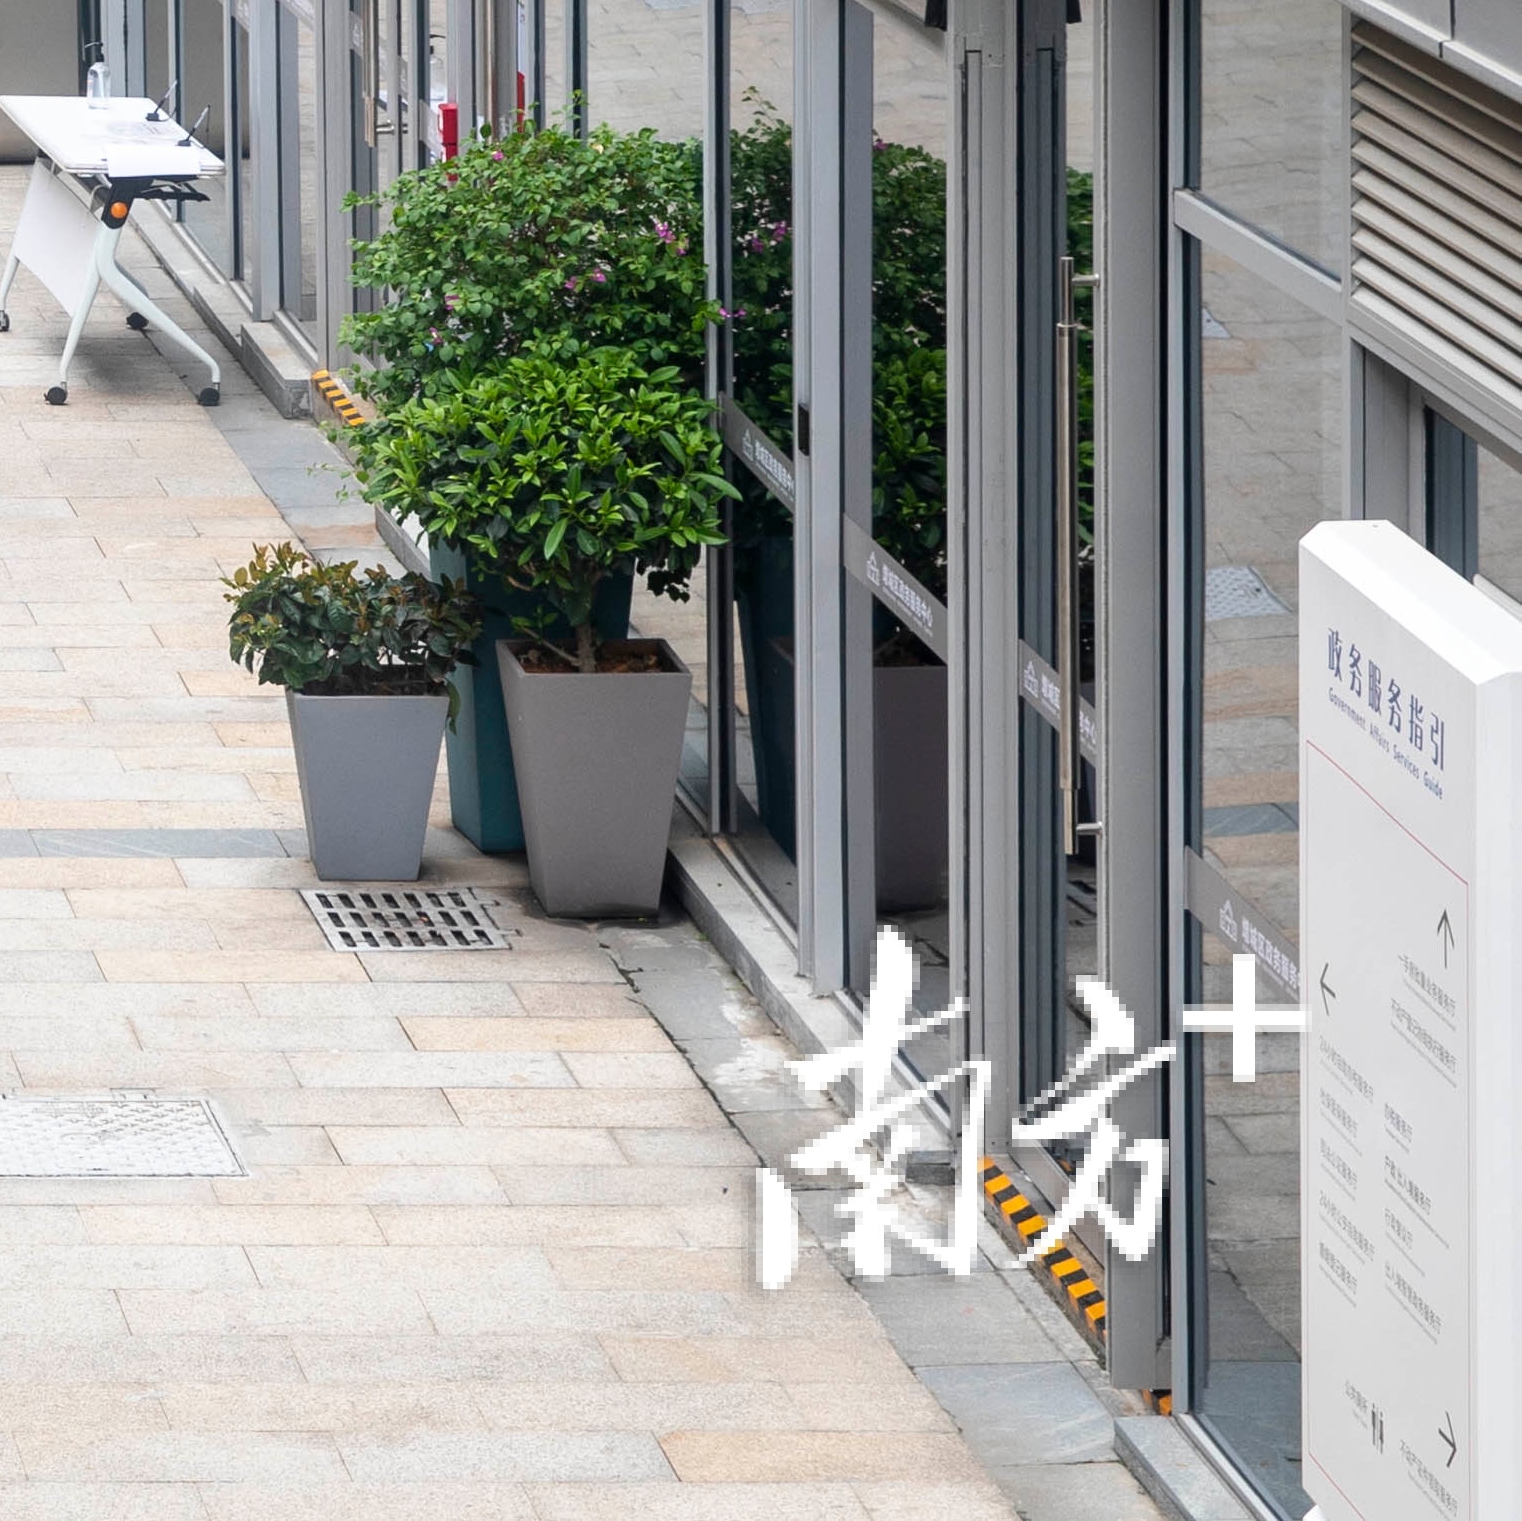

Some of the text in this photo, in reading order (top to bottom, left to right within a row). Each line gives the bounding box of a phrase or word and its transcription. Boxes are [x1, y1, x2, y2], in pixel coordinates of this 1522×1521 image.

[1328, 628, 1444, 772] 政务服务指引
[1328, 686, 1443, 800] Government Affairs Services Guide
